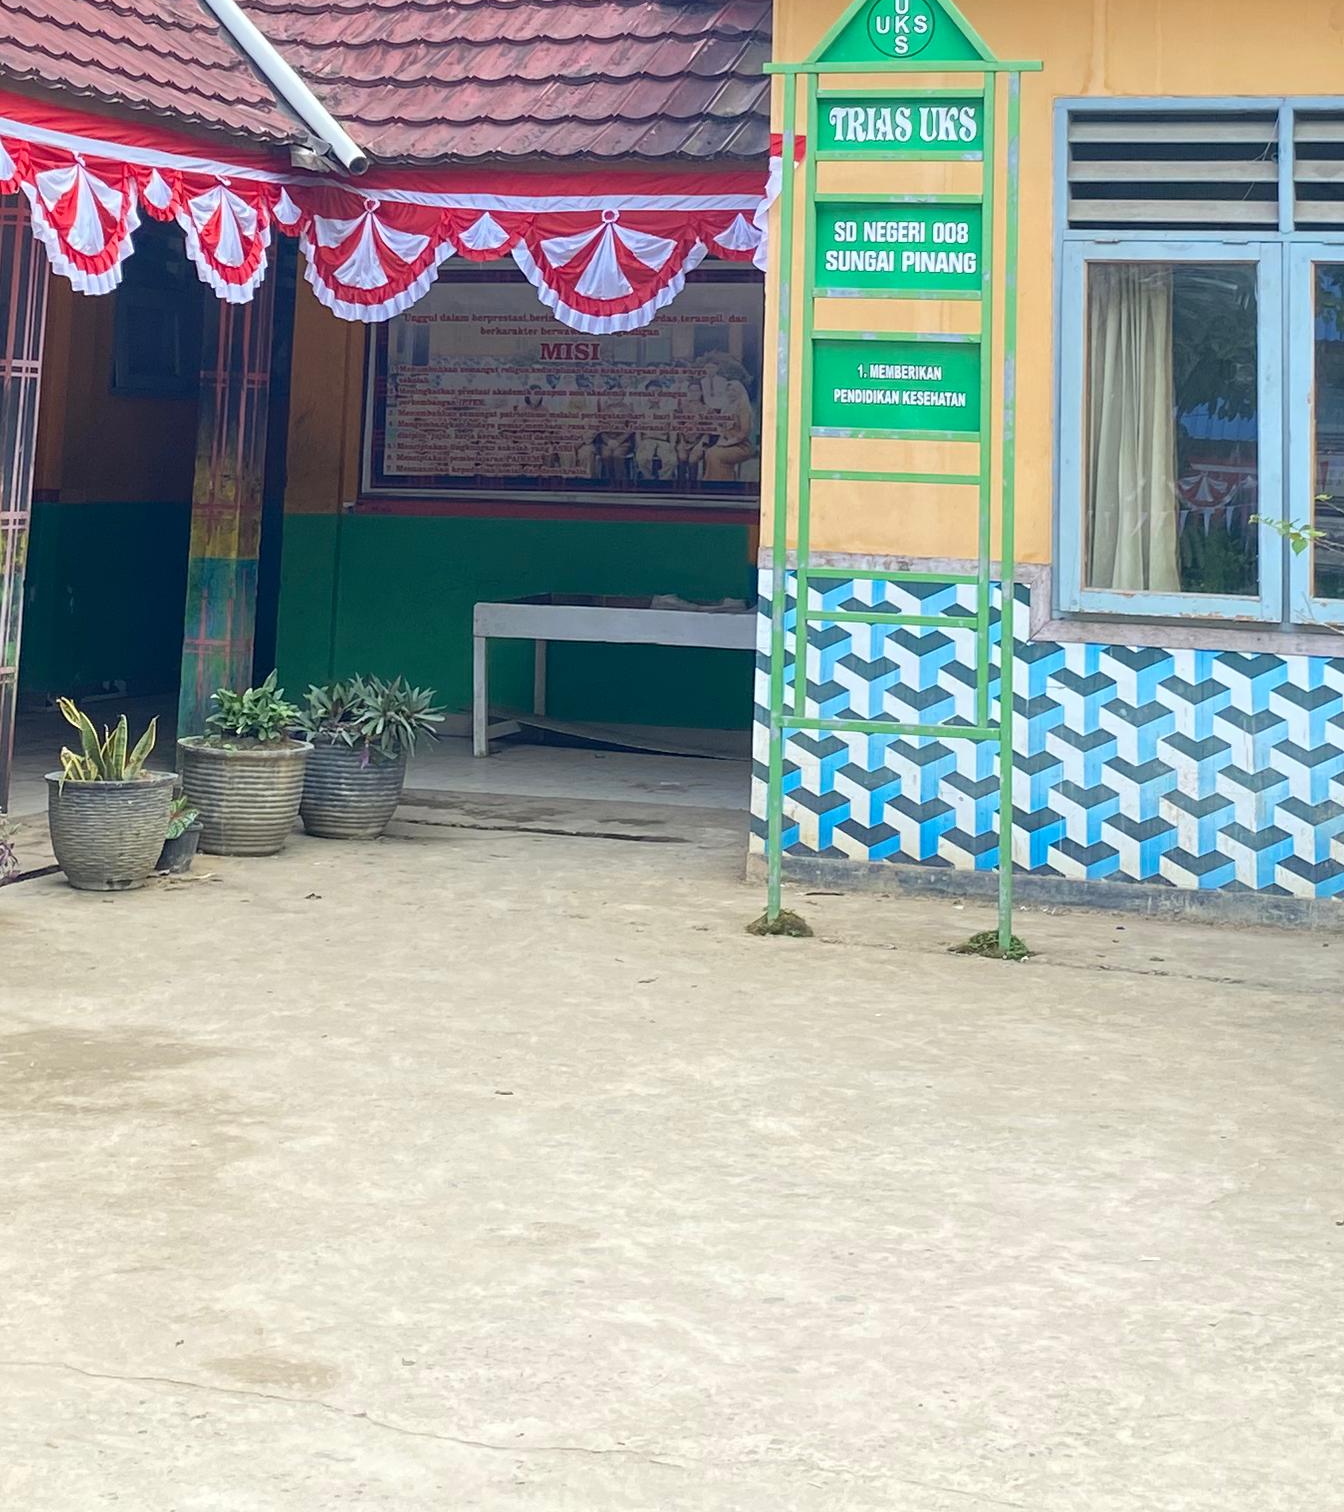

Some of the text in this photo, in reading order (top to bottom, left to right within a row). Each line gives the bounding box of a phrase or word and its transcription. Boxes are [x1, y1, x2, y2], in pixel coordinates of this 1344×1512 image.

[876, 15, 928, 34] UKS
[829, 107, 977, 142] TRIAS UKS
[834, 221, 969, 244] SD NEGERI 008
[825, 251, 977, 274] SUNGAI PINANG
[540, 343, 601, 361] MISI
[857, 364, 942, 381] 1. MEMBERIKAN
[834, 389, 965, 407] PENDIDIKAN KESEHATAN
